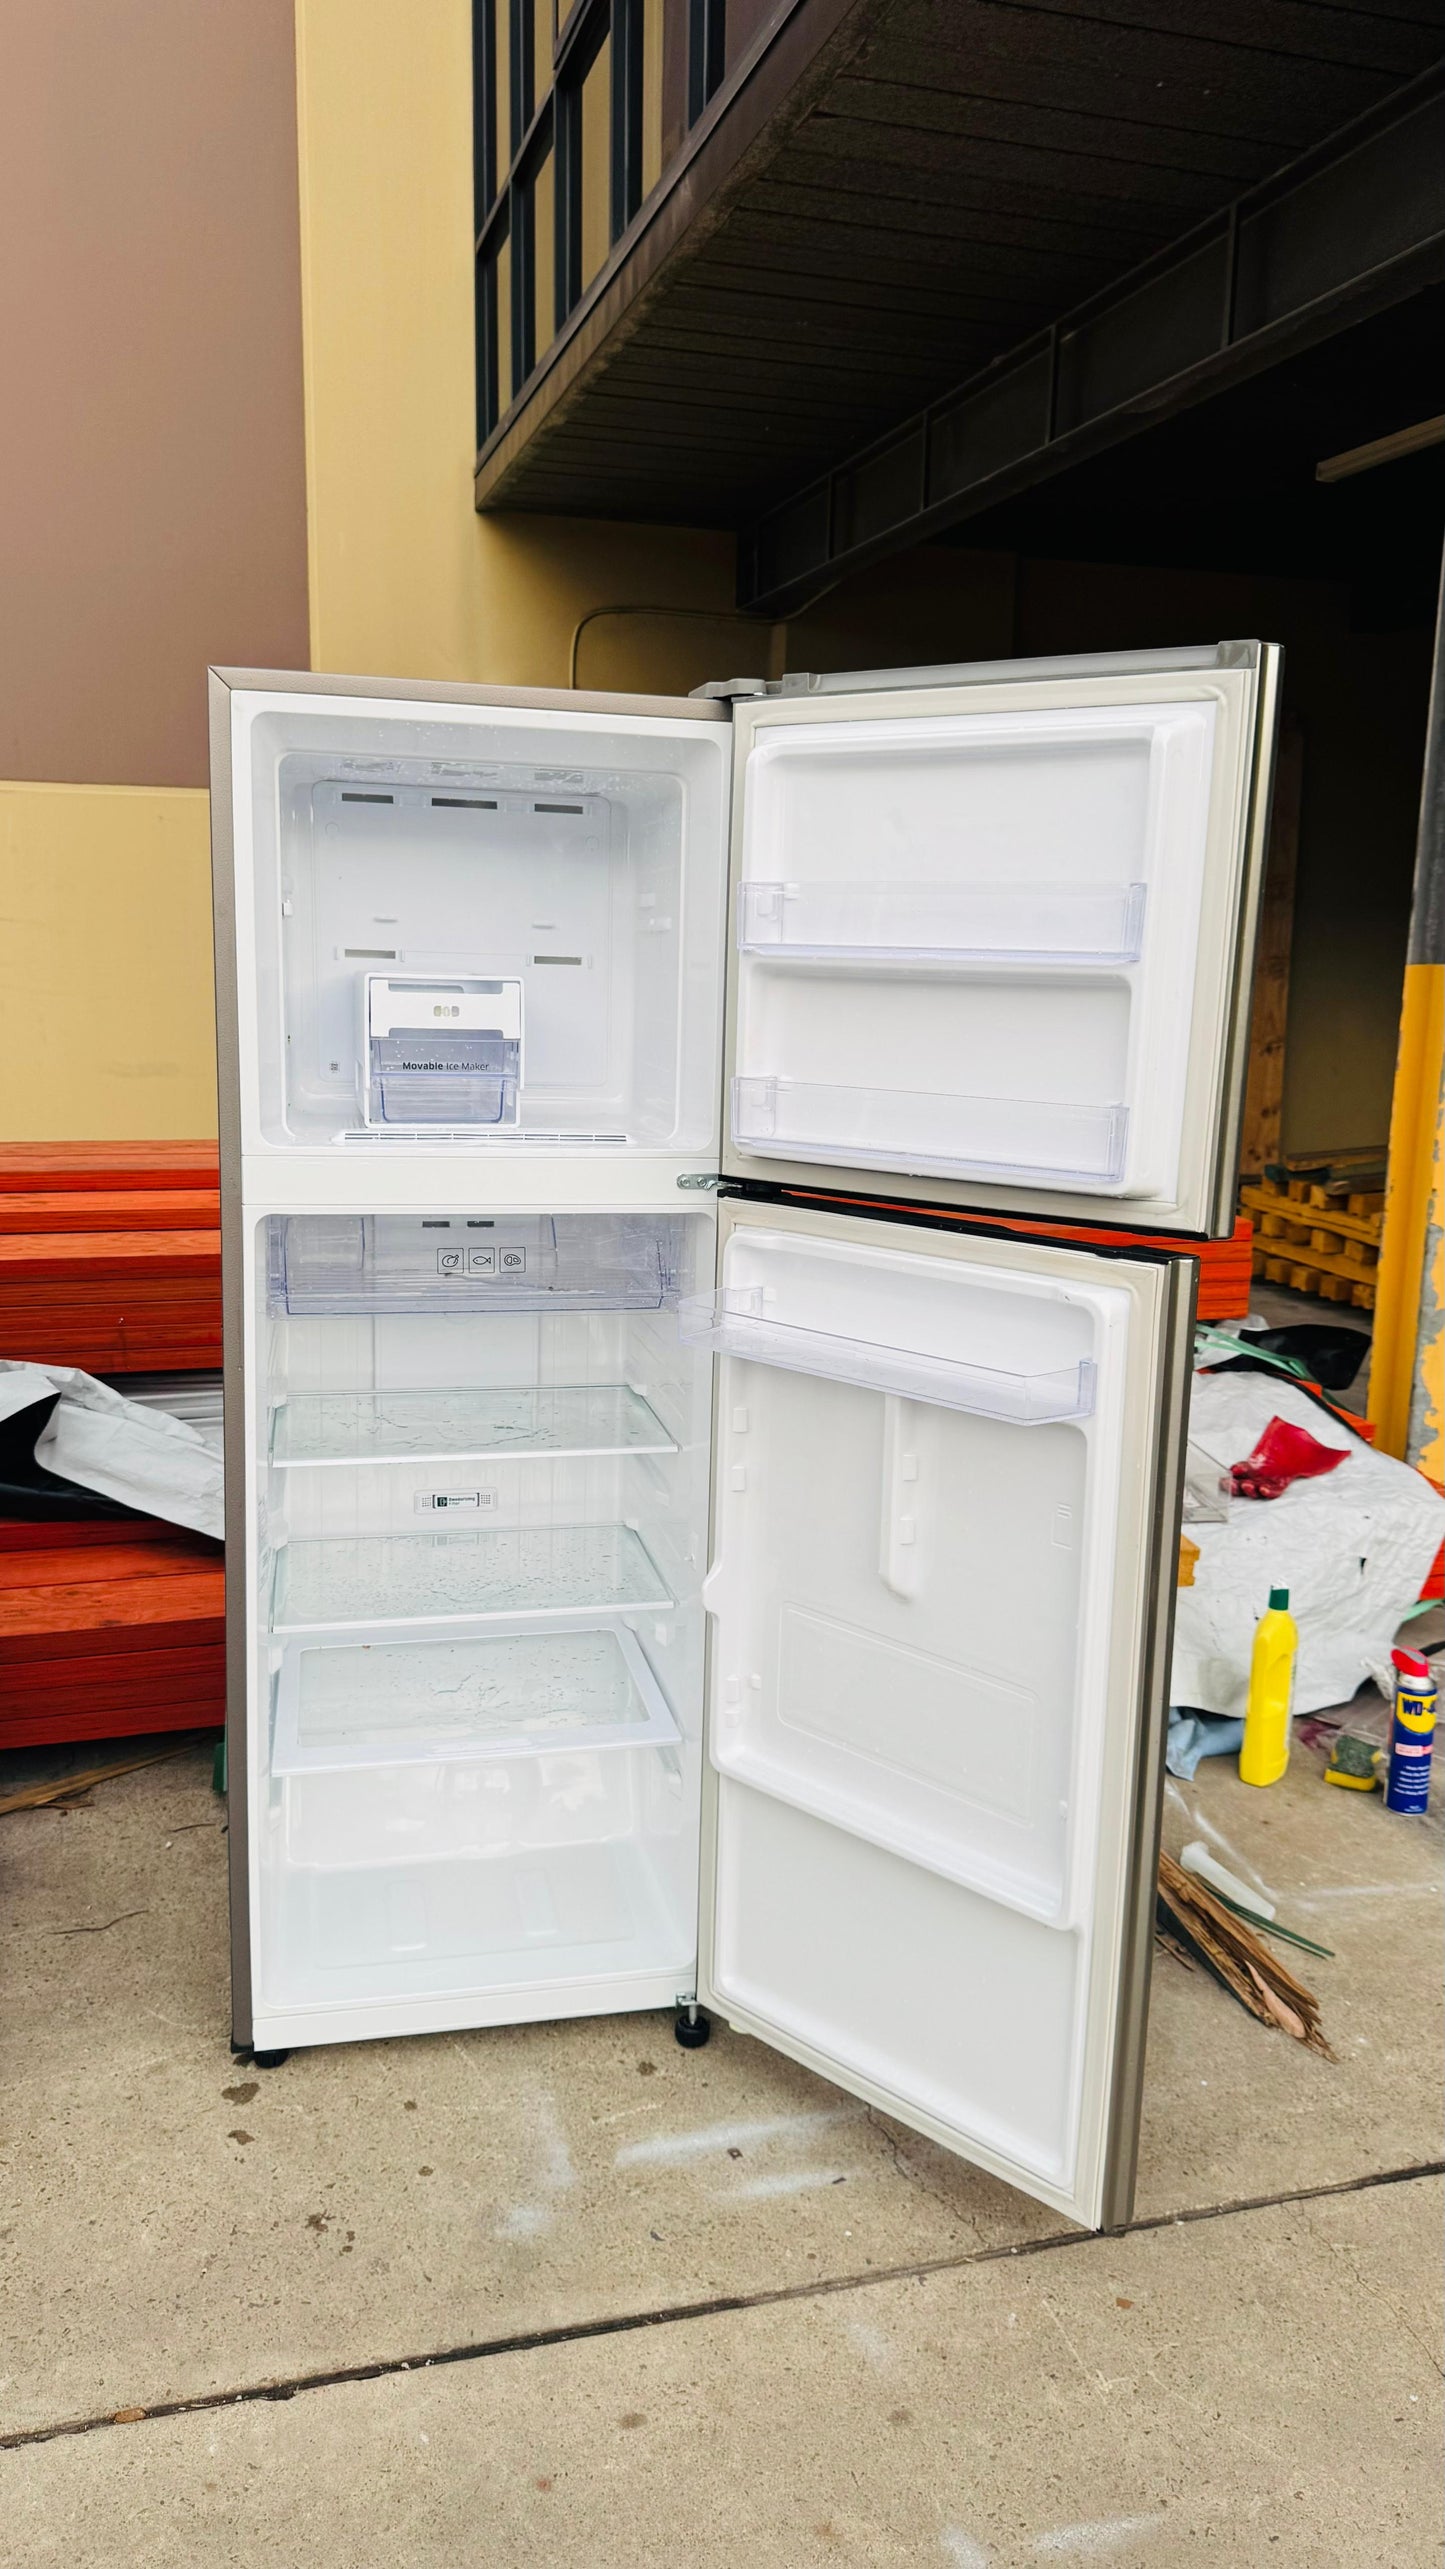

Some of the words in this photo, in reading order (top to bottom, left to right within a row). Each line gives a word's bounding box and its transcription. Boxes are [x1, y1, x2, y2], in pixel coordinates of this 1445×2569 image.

[402, 1062, 443, 1070] Movable
[446, 1062, 459, 1070] Ice
[461, 1062, 489, 1071] Maker
